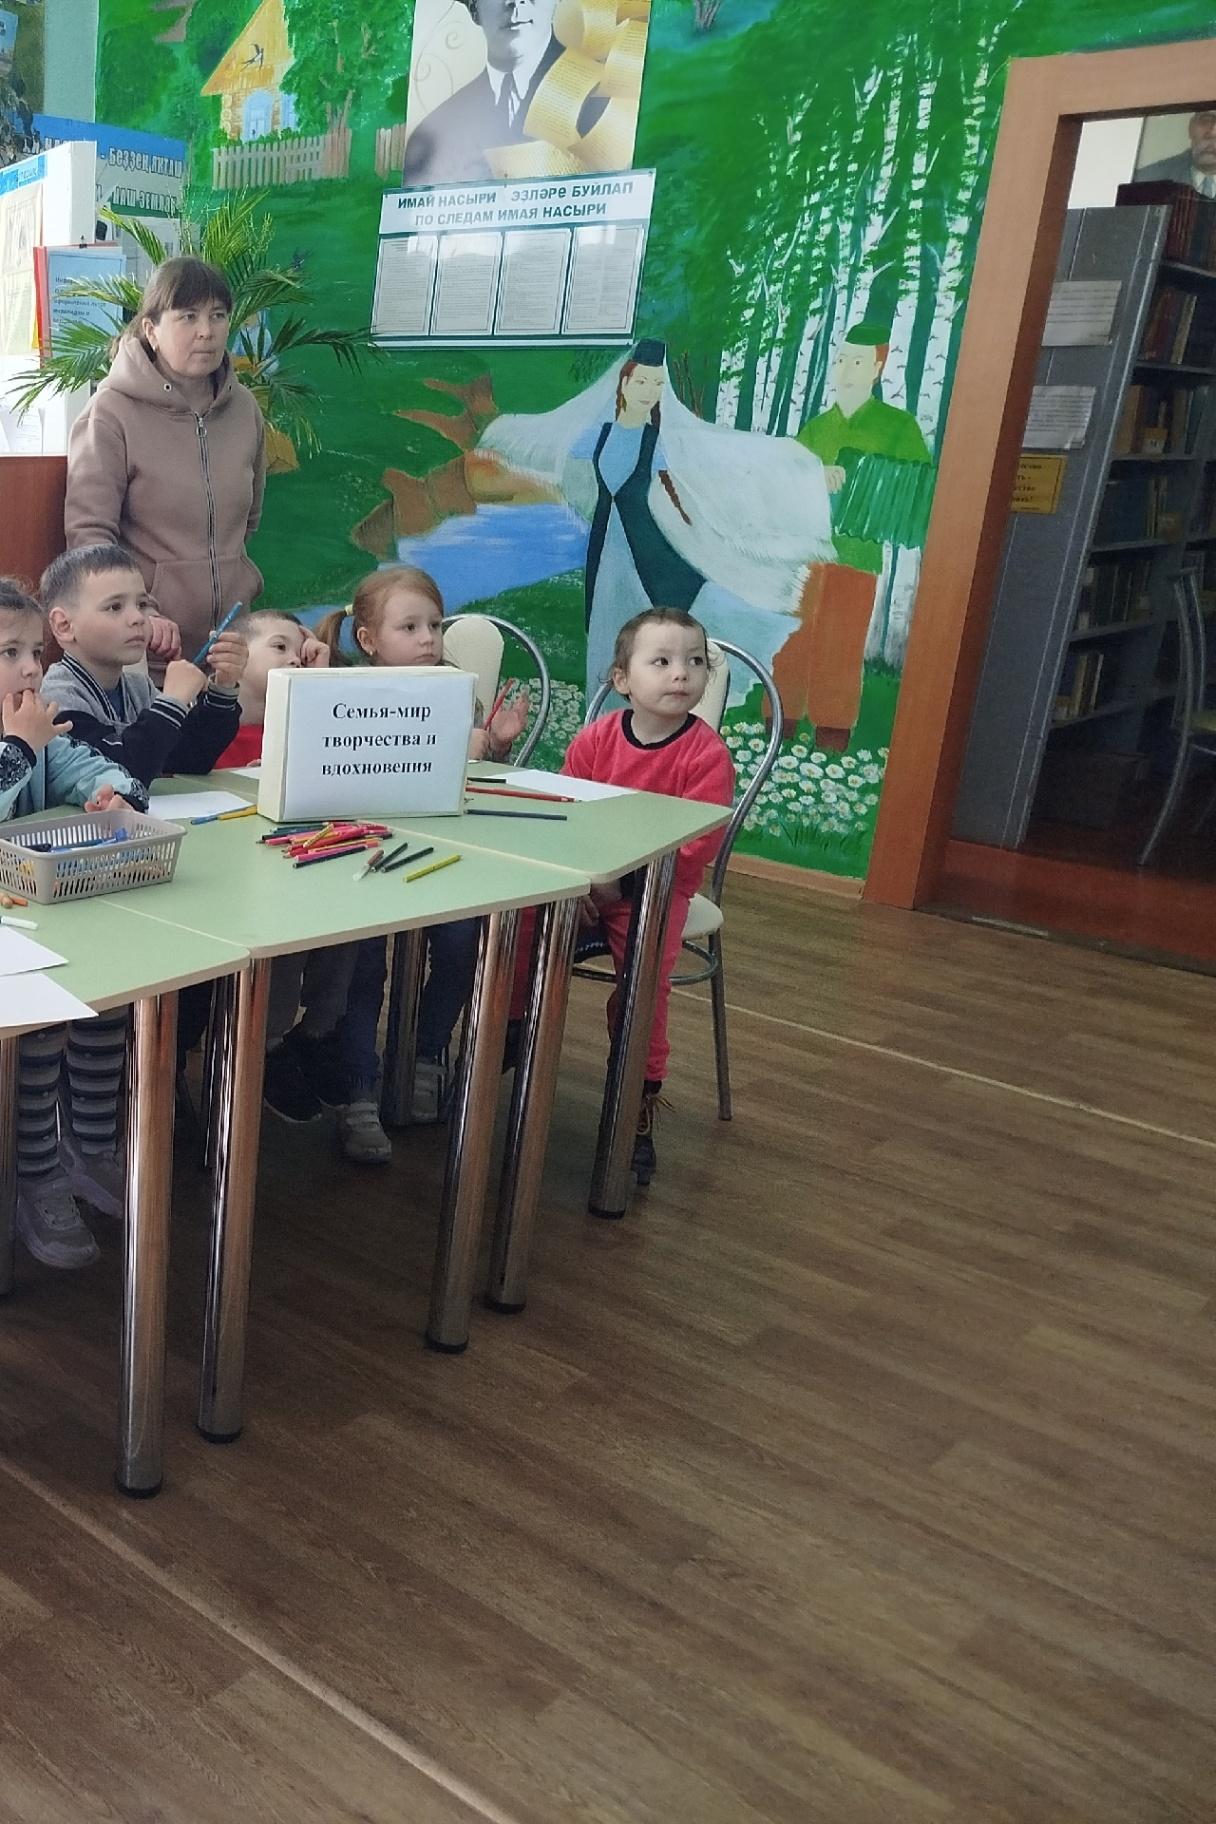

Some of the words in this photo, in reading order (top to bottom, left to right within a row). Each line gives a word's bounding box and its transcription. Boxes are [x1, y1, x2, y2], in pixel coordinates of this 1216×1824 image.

[398, 194, 434, 209] ИМАЙ
[437, 192, 496, 207] НАСЫРИ
[571, 181, 634, 198] БУЙЛАП
[415, 214, 434, 226] ПО
[437, 210, 493, 225] СЛЕДАМ
[497, 207, 538, 221] ИМАЯ
[542, 203, 607, 218] НАСЫРИ
[333, 702, 431, 722] Семья-мир
[322, 733, 421, 750] творчества
[426, 733, 437, 745] и
[322, 761, 432, 776] вдохновения
